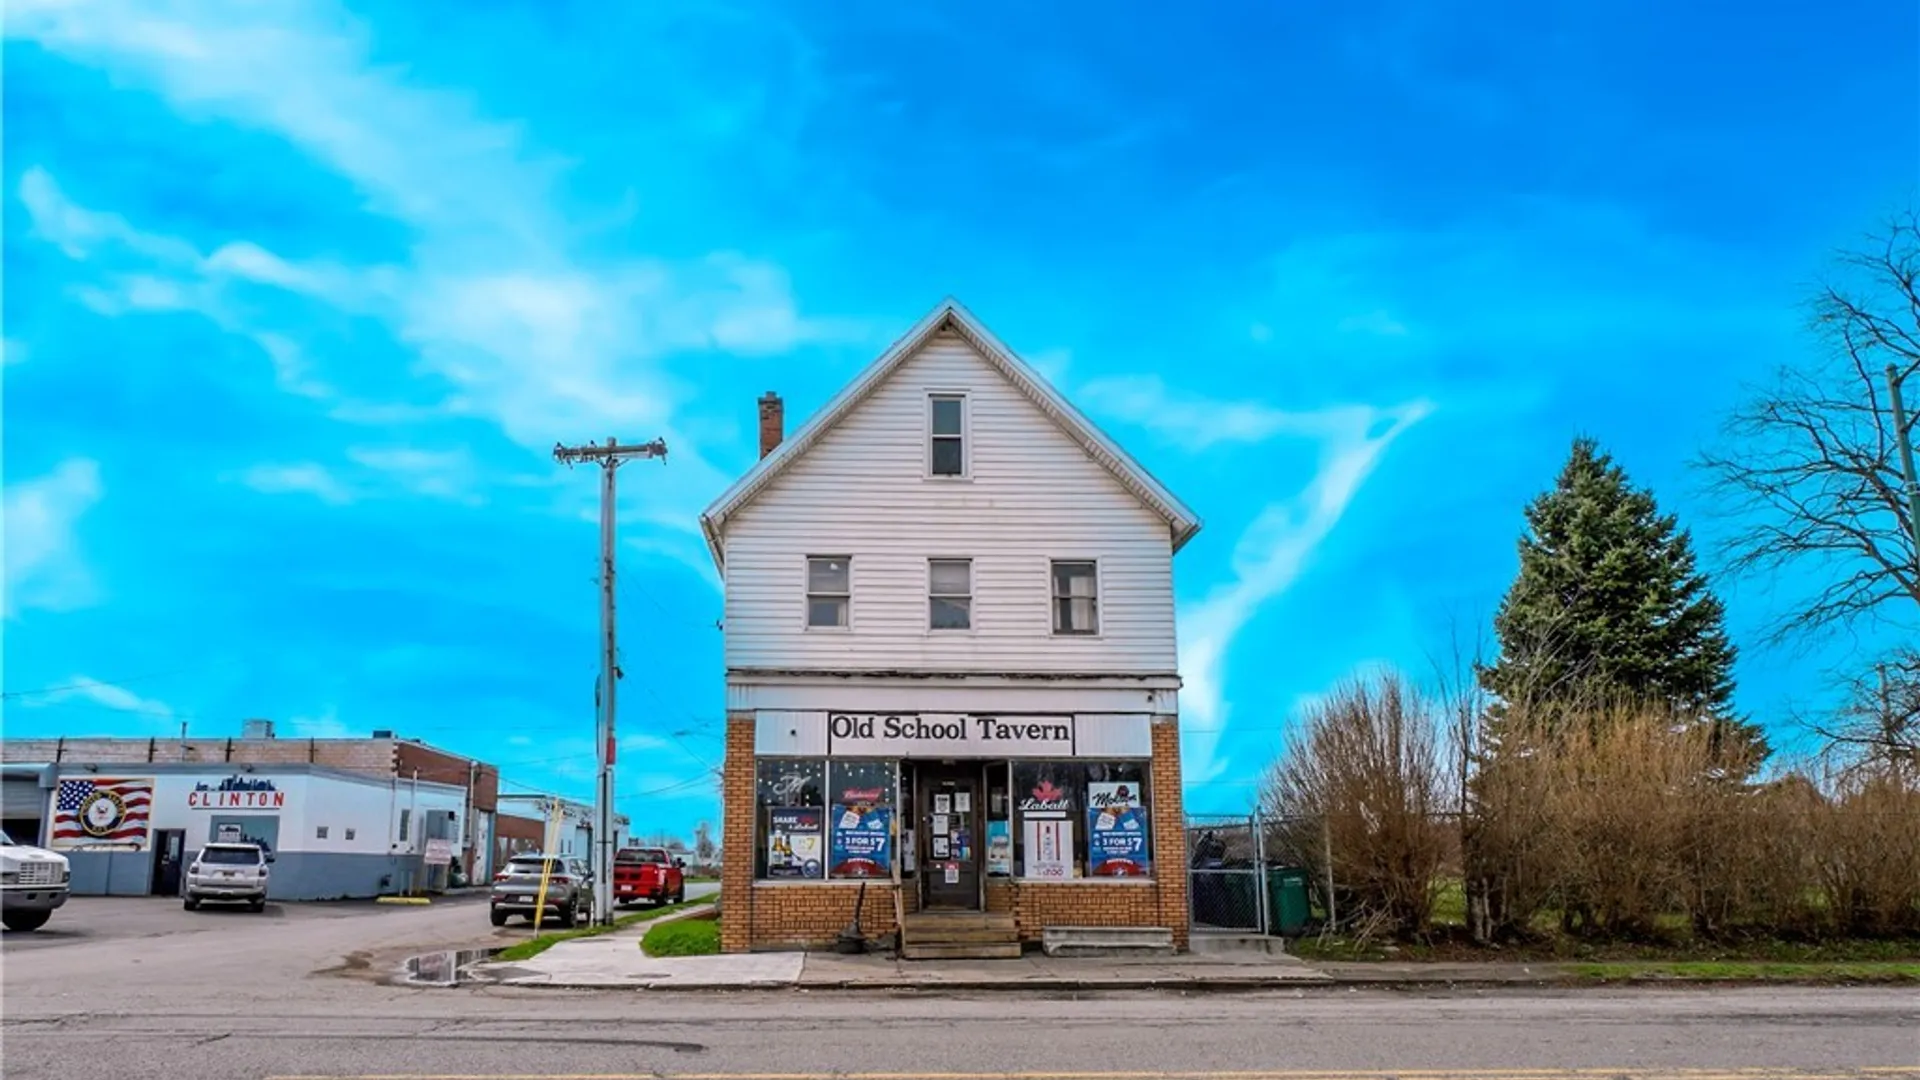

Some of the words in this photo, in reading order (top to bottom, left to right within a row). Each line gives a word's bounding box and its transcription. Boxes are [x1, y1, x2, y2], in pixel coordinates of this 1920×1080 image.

[832, 716, 874, 739] Old
[883, 716, 967, 739] School
[977, 718, 1070, 741] Tavern
[188, 792, 285, 807] CLINTON
[1018, 797, 1070, 811] Labatt
[851, 837, 870, 846] FOR
[1108, 837, 1127, 846] FOR
